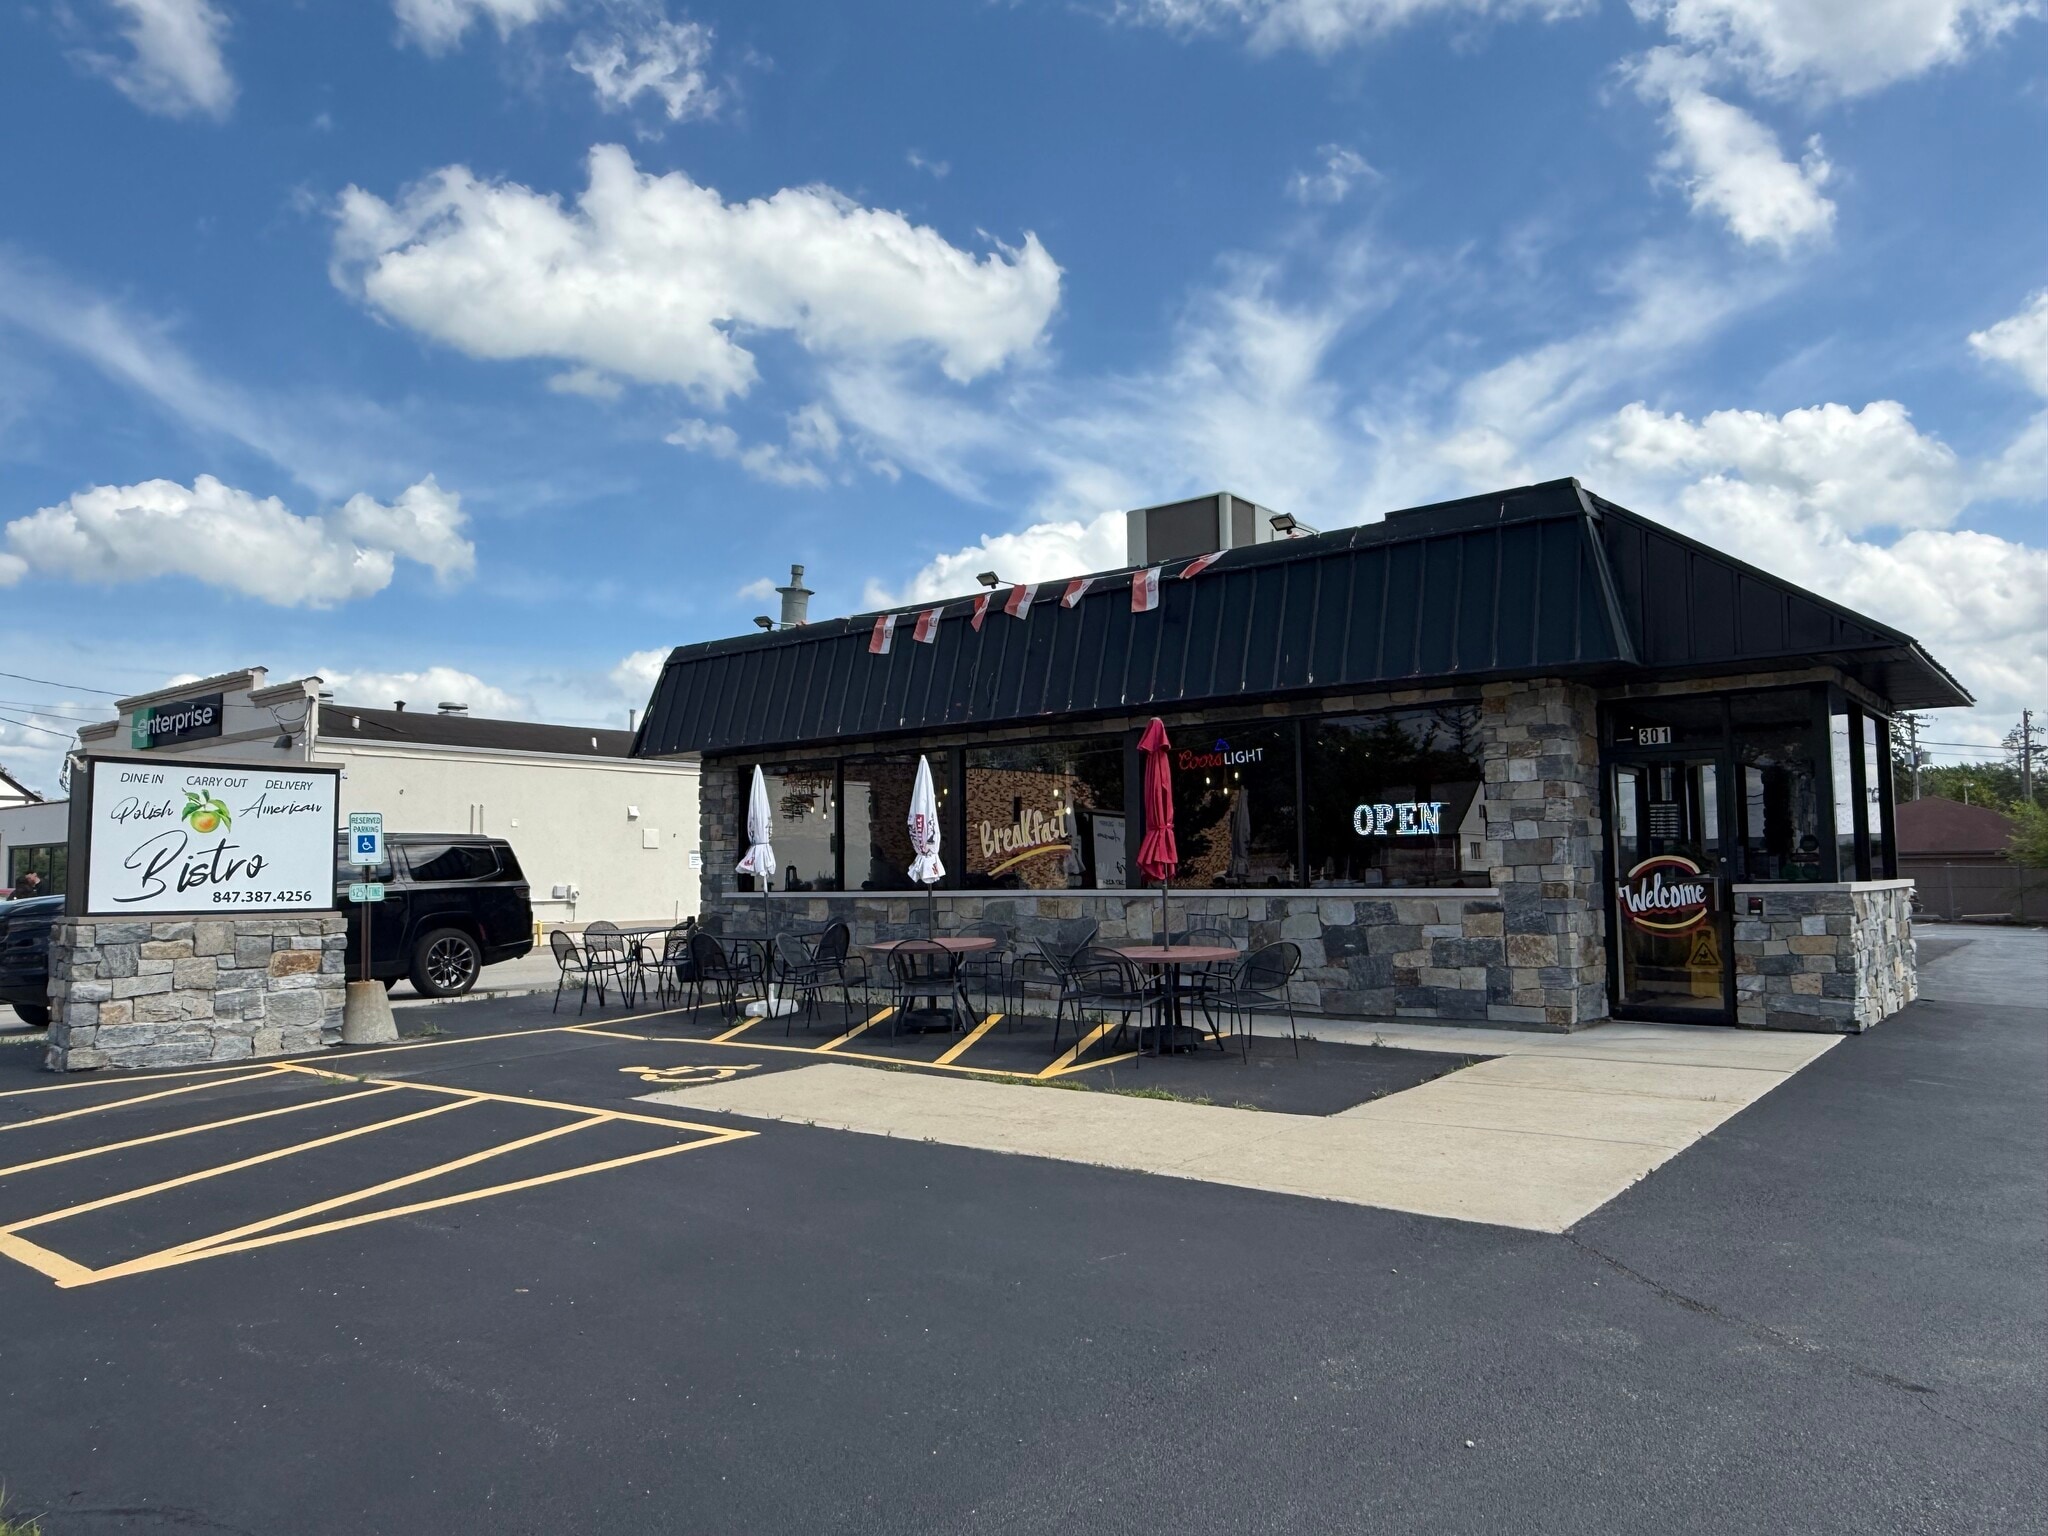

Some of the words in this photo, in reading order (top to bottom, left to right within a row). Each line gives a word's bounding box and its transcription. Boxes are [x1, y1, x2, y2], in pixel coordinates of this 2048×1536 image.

[137, 705, 213, 738] enterprise
[1640, 727, 1669, 744] 301
[1178, 749, 1222, 770] Coors
[1223, 747, 1264, 765] LIGHT
[120, 772, 149, 784] DINE
[151, 774, 164, 784] IN
[186, 776, 223, 788] CARRY
[224, 778, 248, 788] OUT
[265, 779, 313, 791] DELIVERY
[110, 797, 174, 825] Polish
[238, 793, 322, 819] American
[351, 816, 381, 825] RESERVED
[1353, 801, 1443, 836] OPEN
[353, 825, 379, 833] PARKING
[113, 829, 269, 903] Bistro
[212, 890, 312, 903] 847.387.4256
[1618, 872, 1707, 912] Welcome
